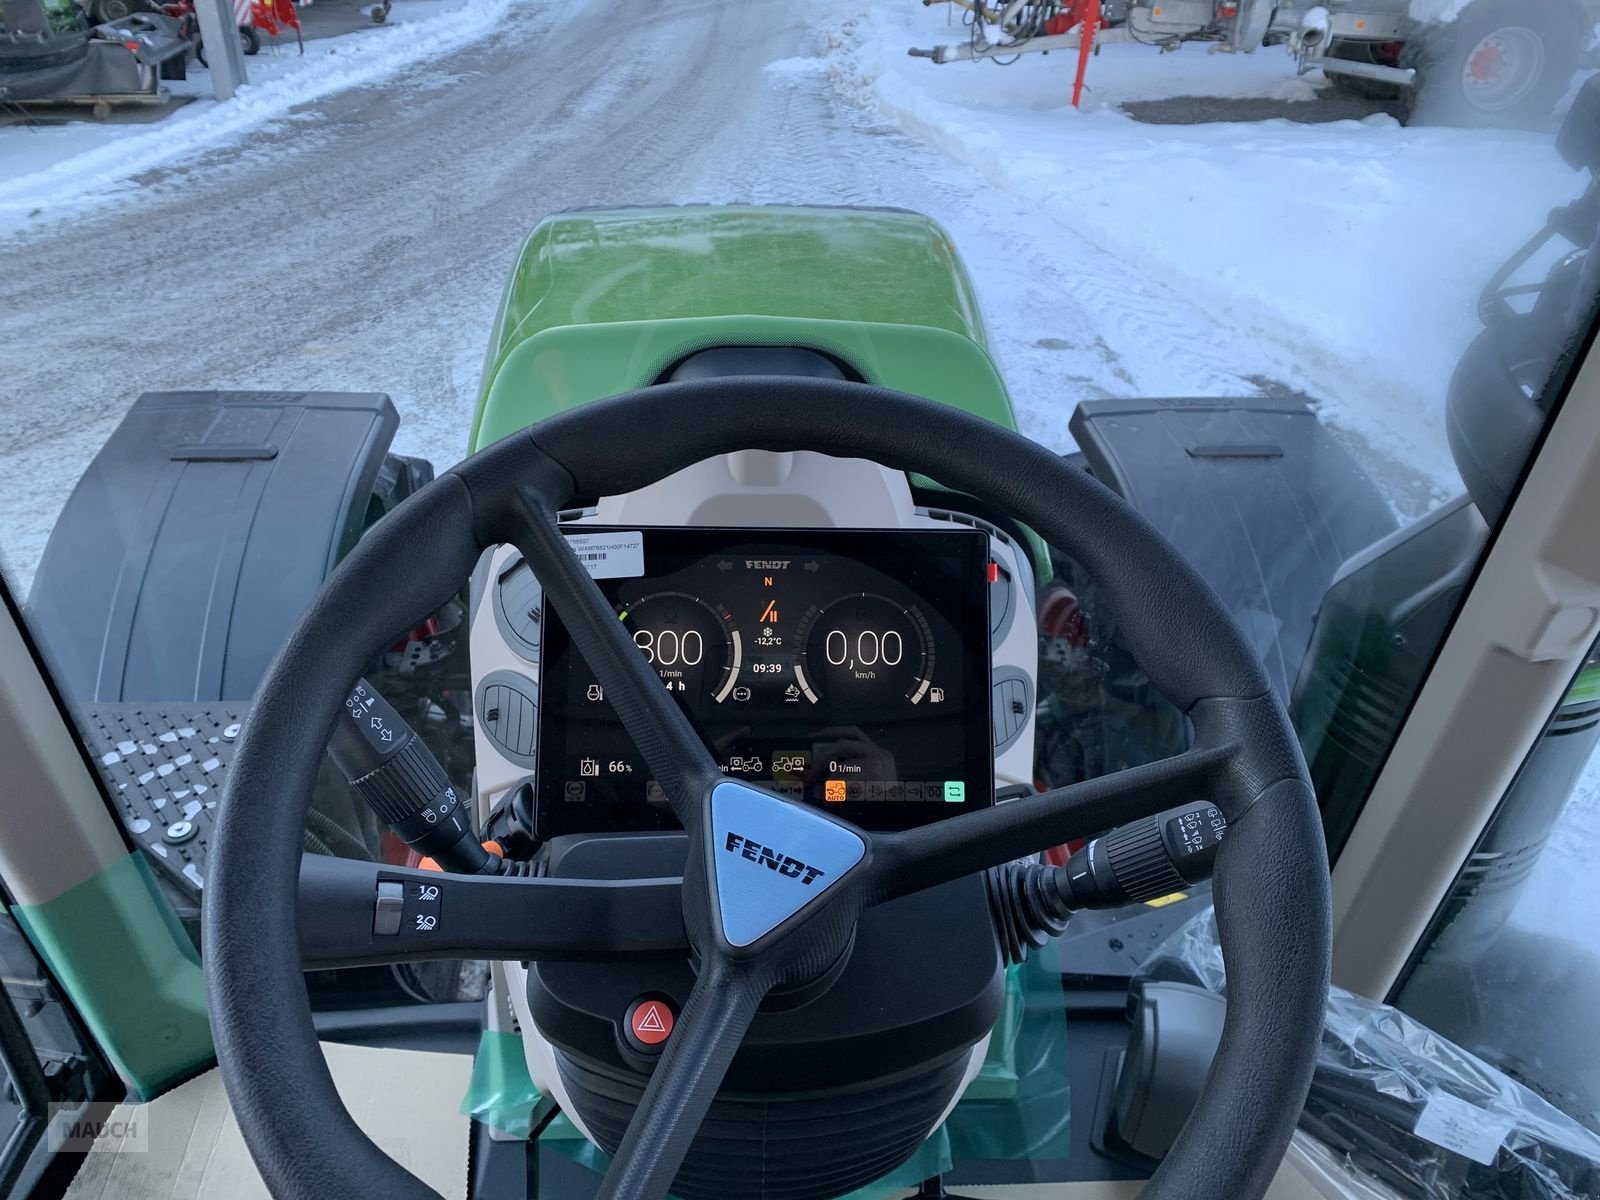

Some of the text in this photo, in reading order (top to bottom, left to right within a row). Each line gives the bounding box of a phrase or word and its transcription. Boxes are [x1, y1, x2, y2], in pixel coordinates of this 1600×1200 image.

[745, 560, 791, 569] FENDT
[764, 577, 773, 586] N
[754, 637, 782, 646] -12,2°C
[826, 630, 903, 670] 0,00
[753, 664, 782, 673] 09:39
[659, 670, 682, 678] 1/min
[855, 671, 876, 679] km/h
[678, 681, 686, 691] h
[725, 831, 825, 886] FENDT
